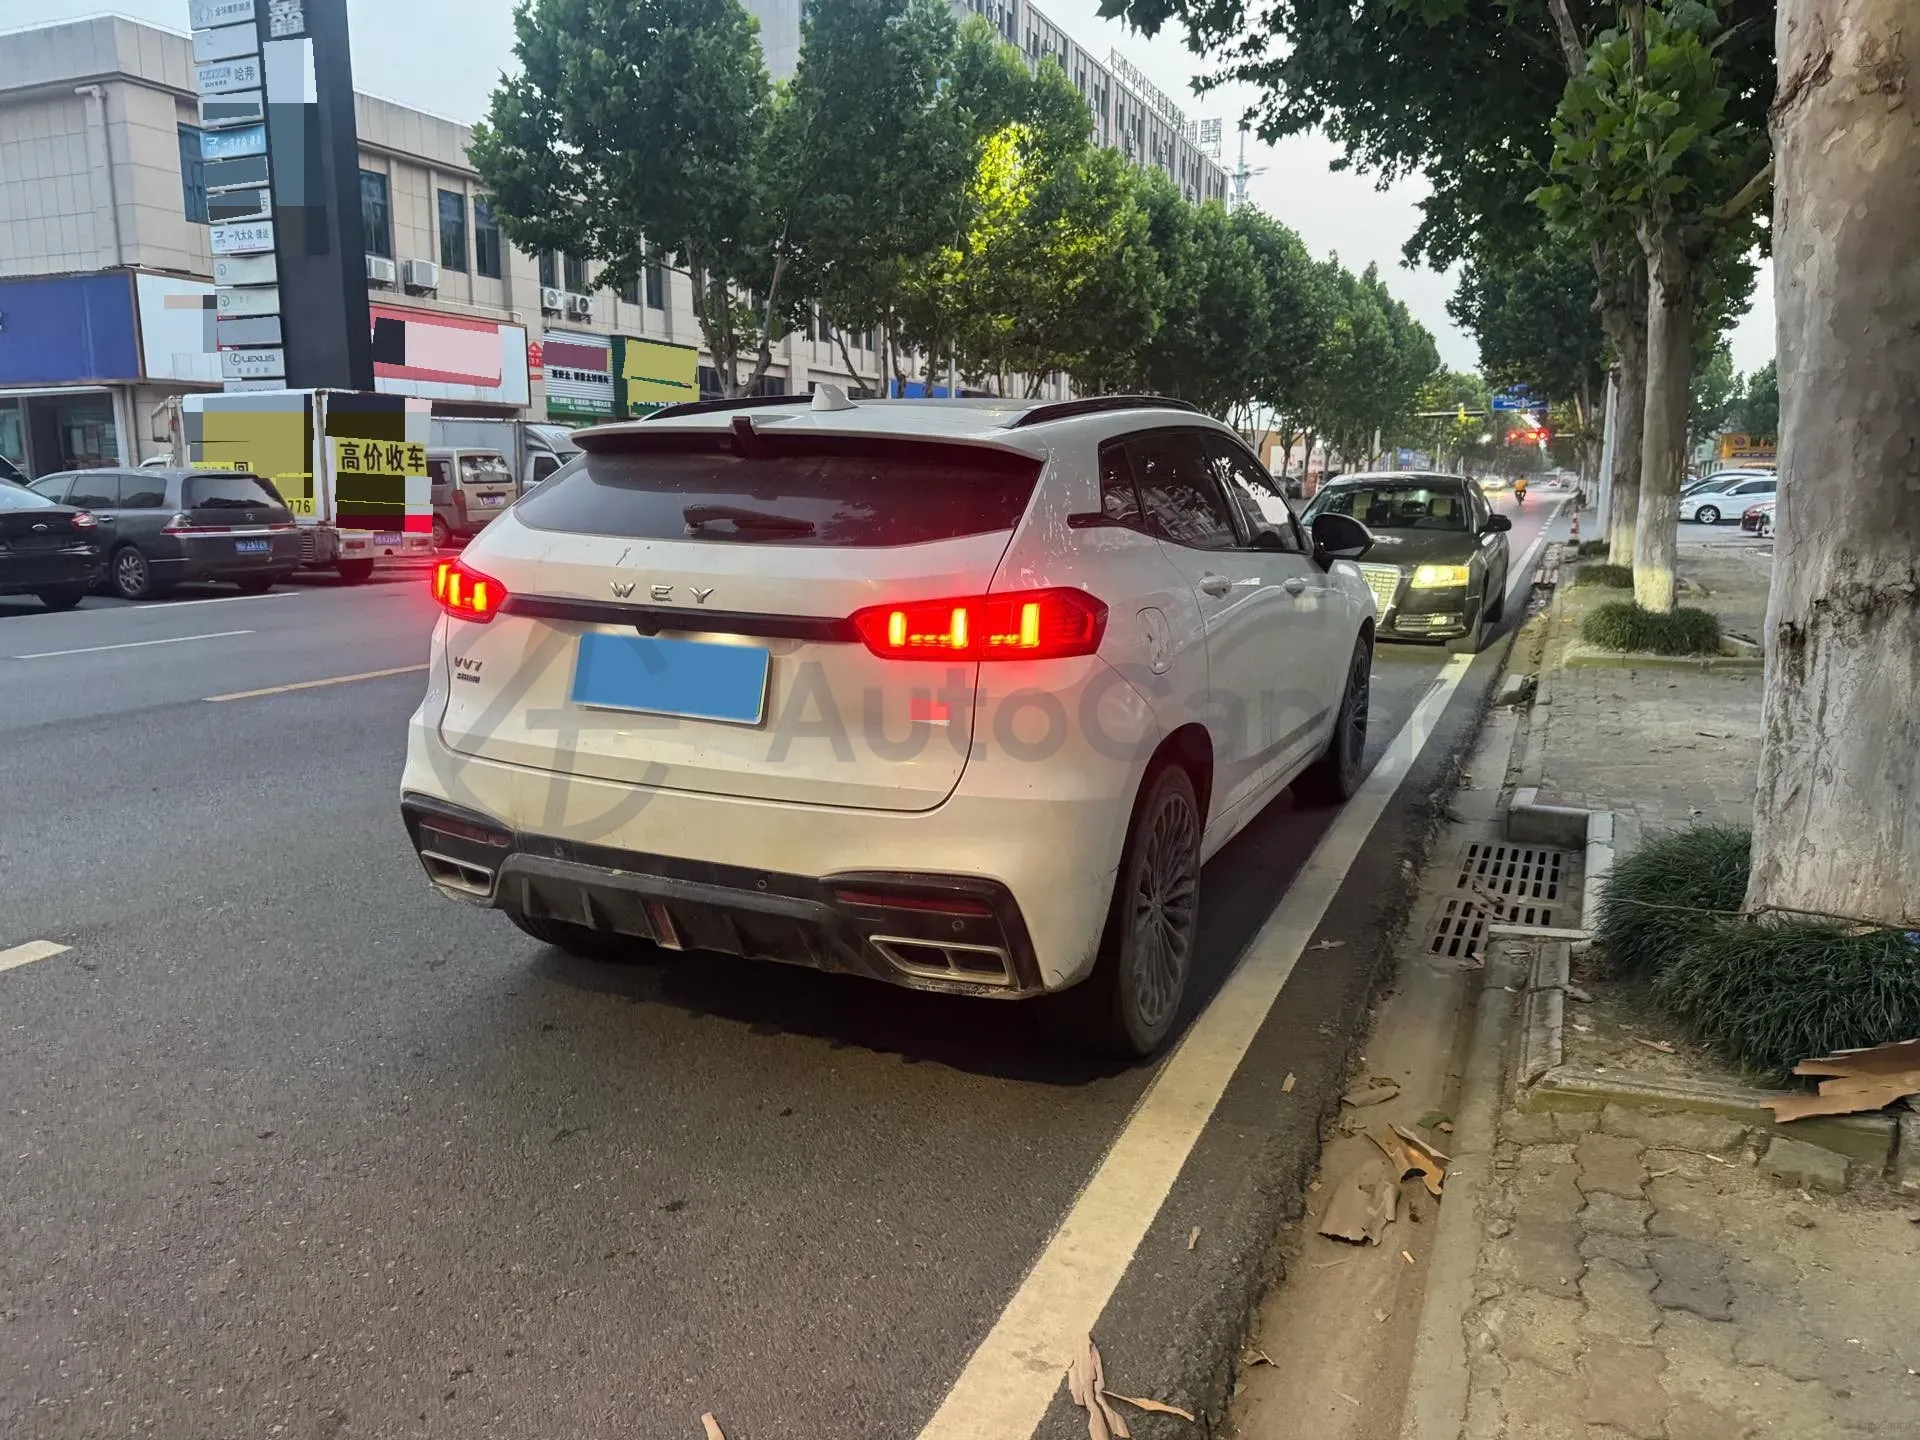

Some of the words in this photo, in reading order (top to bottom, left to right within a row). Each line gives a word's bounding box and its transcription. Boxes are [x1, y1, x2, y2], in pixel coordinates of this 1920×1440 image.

[234, 66, 255, 81] 哈弗
[241, 354, 276, 363] LEXUS
[339, 441, 425, 473] 高价收车
[287, 500, 311, 513] 776
[609, 580, 714, 604] WEY
[454, 656, 483, 671] VV7
